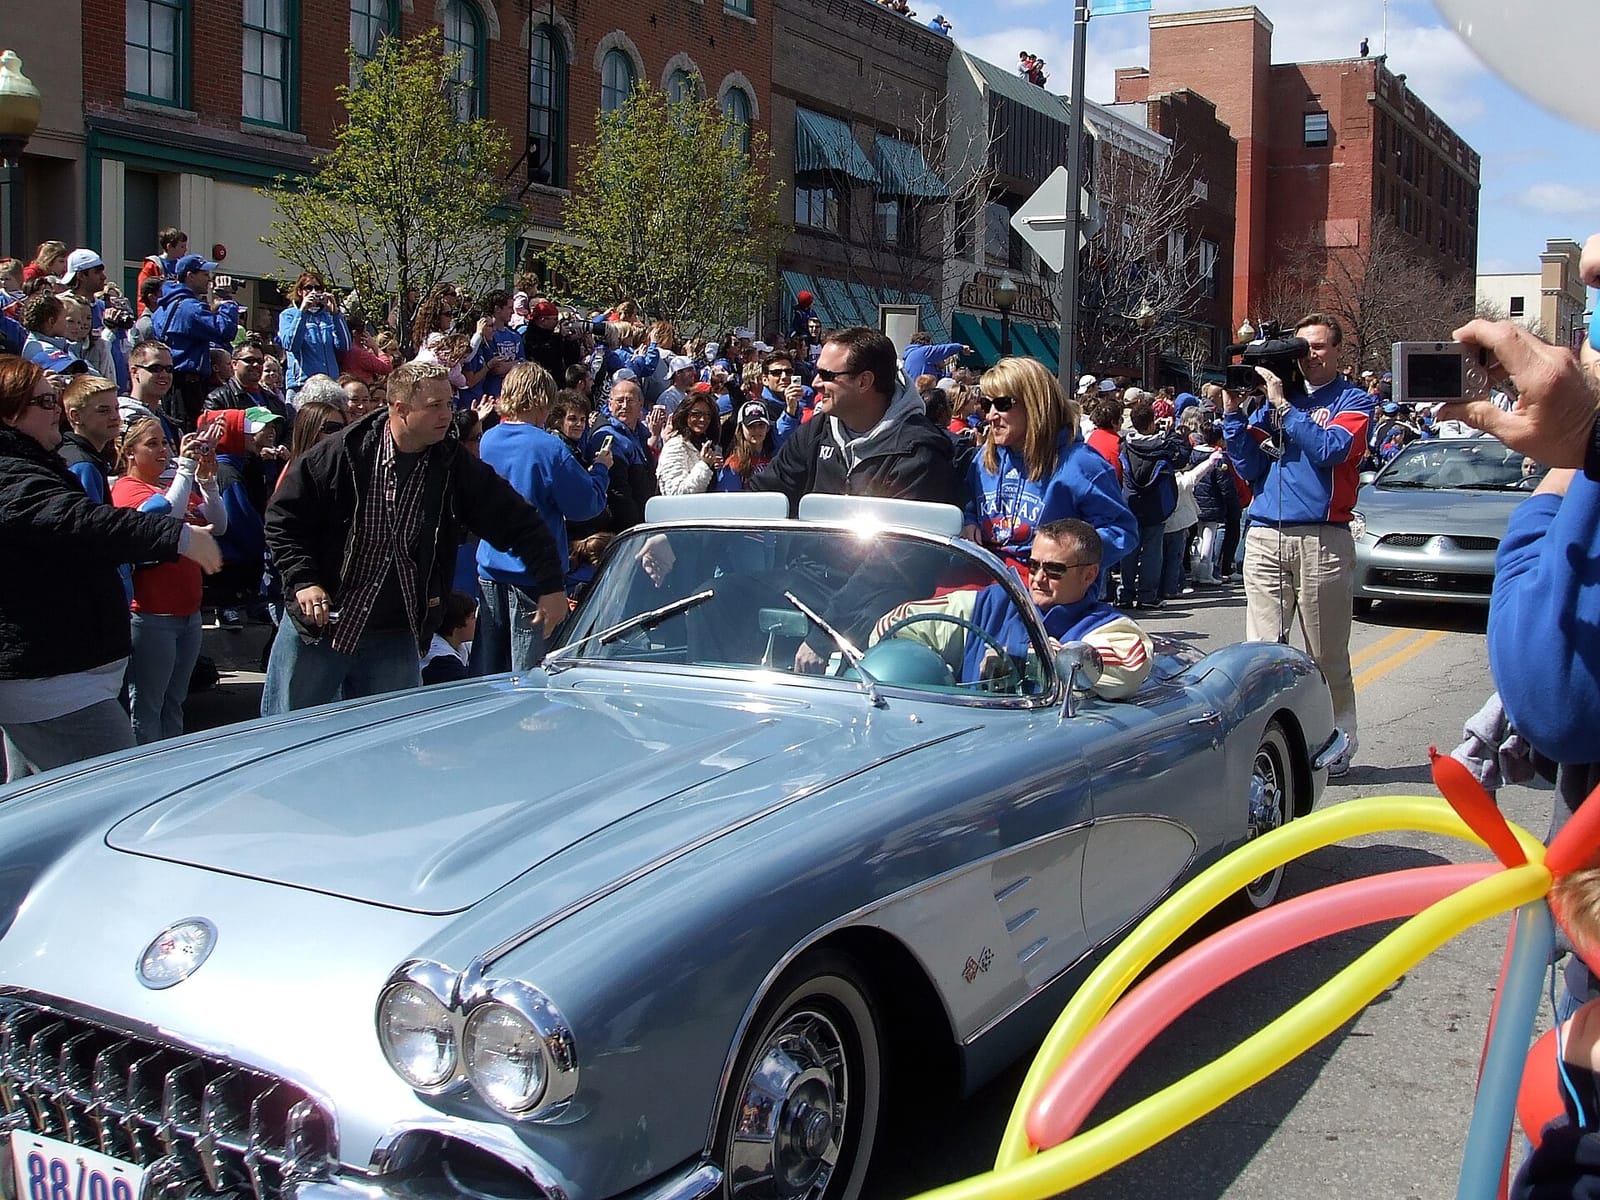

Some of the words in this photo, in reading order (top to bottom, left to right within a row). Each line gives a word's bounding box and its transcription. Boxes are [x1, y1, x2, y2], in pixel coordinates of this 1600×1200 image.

[968, 286, 1050, 316] SMOHOUSE
[819, 445, 835, 460] KU
[981, 500, 1040, 522] KANAS
